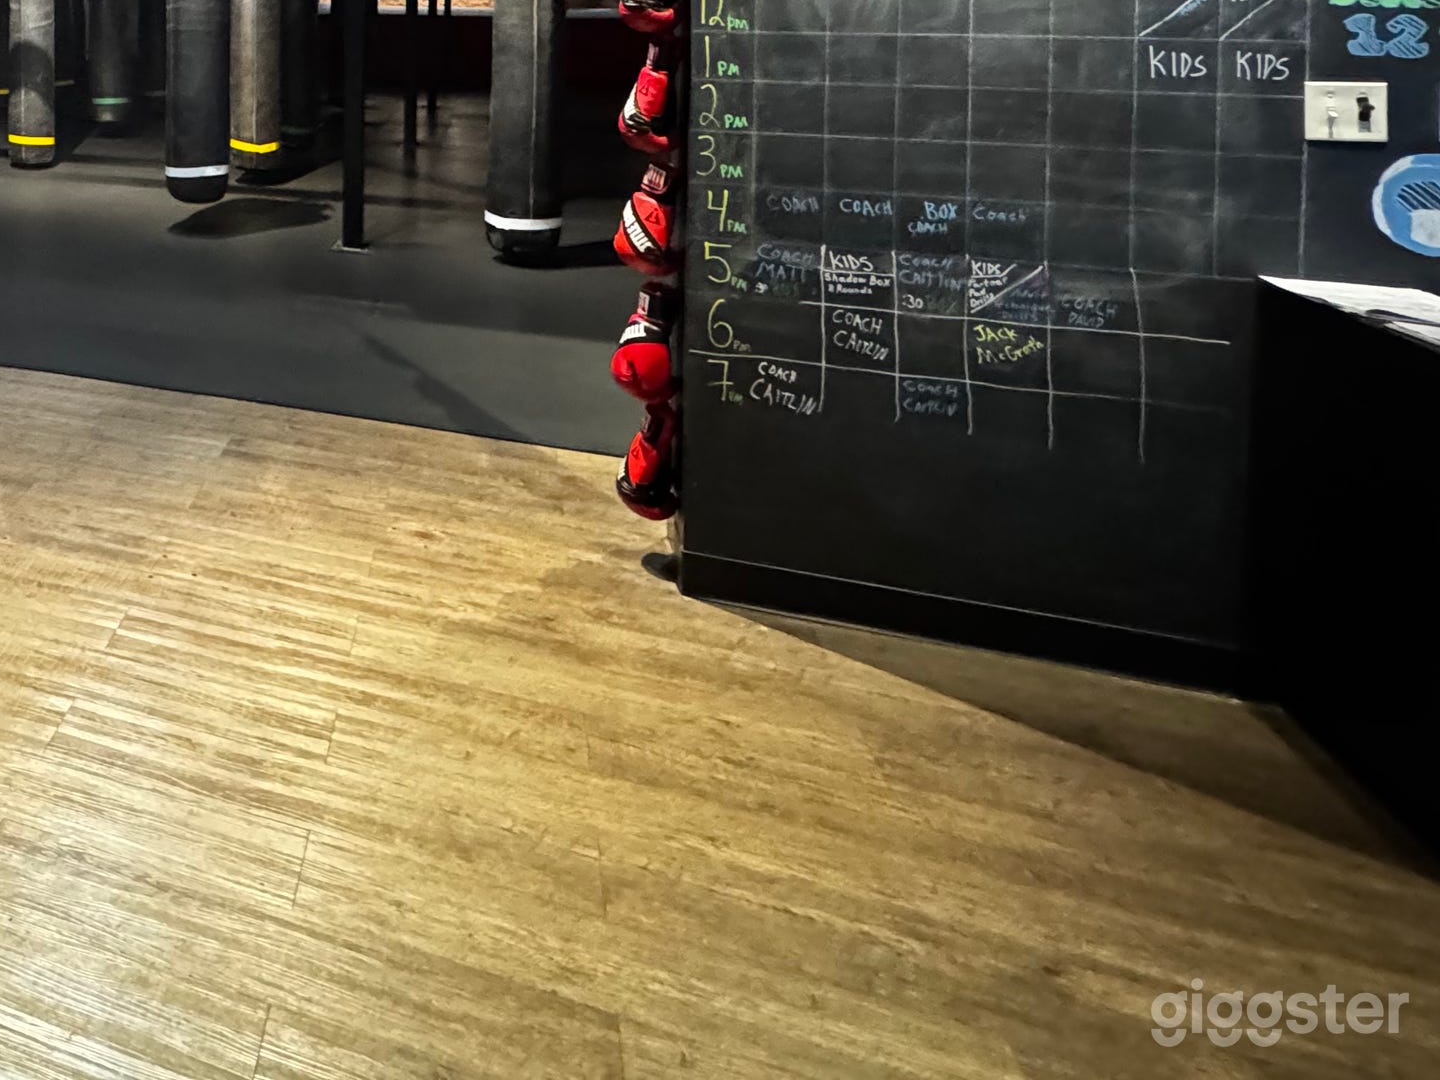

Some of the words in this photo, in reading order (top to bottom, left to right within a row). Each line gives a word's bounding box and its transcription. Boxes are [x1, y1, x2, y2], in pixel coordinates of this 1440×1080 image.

[1343, 13, 1430, 60] 12
[1148, 45, 1208, 79] KIDS
[1236, 50, 1290, 80] KIDS
[699, 83, 720, 128] 2
[724, 114, 748, 129] PM
[697, 135, 717, 176] 3
[720, 164, 743, 178] PM
[707, 189, 729, 232] 4
[839, 199, 893, 217] COACH
[923, 201, 959, 221] BOX
[704, 241, 732, 283] 5
[755, 262, 806, 283] MATT
[829, 250, 874, 271] KIDS
[971, 260, 1002, 277] KIDS
[707, 299, 733, 348] 6
[832, 309, 883, 335] COACH
[706, 359, 734, 402] 7
[757, 361, 798, 384] COACH
